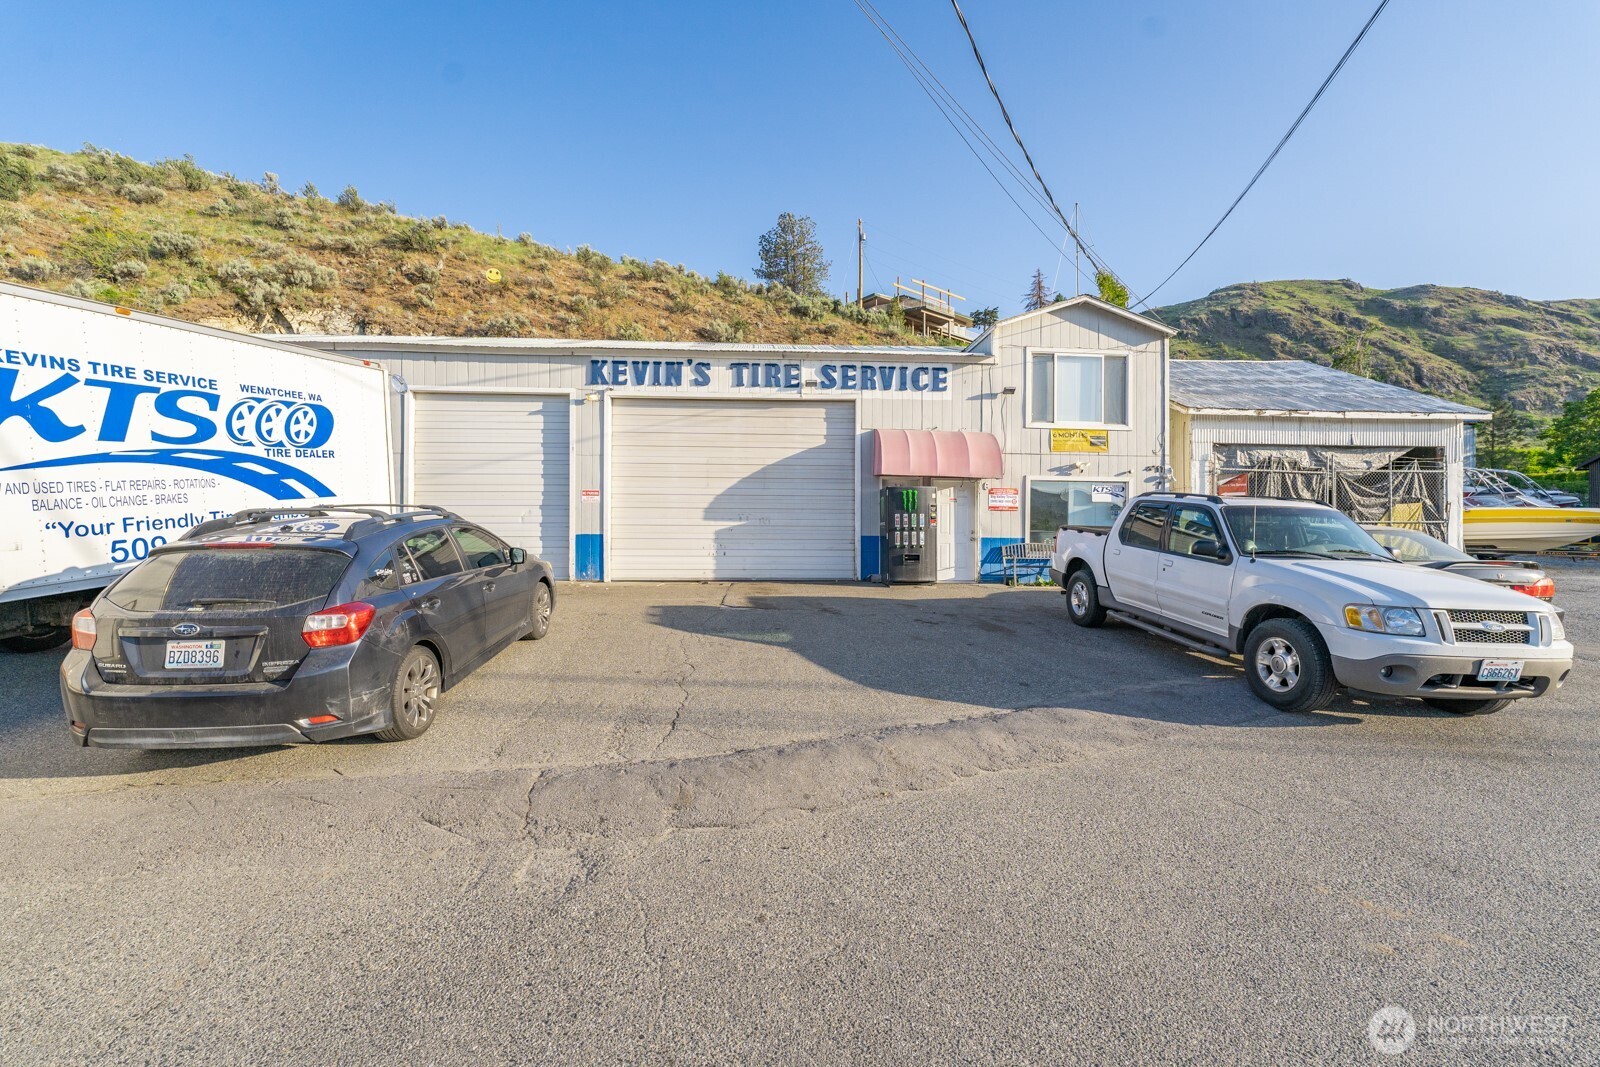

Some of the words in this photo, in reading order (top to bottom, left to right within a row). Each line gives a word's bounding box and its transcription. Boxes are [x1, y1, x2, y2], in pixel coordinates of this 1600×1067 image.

[88, 361, 137, 380] TIRE
[143, 369, 218, 391] SERVICE
[587, 358, 711, 387] KEVIN'S
[730, 362, 800, 389] TIRE
[819, 363, 948, 392] SERVICE
[239, 383, 306, 401] WENATCHEE,
[308, 393, 322, 402] WA
[264, 448, 291, 458] TIRE
[295, 448, 335, 459] DEALER
[5, 482, 30, 495] AND
[33, 481, 64, 494] USED
[66, 480, 97, 493] TIRES
[105, 479, 127, 492] FLAT
[129, 479, 167, 491] REPAIRS
[173, 478, 216, 490] ROTATIONS
[31, 497, 83, 512] BALANCE
[91, 496, 107, 508] OIL
[108, 494, 148, 507] CHANGE
[154, 493, 189, 505] BRAKES
[168, 650, 219, 664] BZD8396
